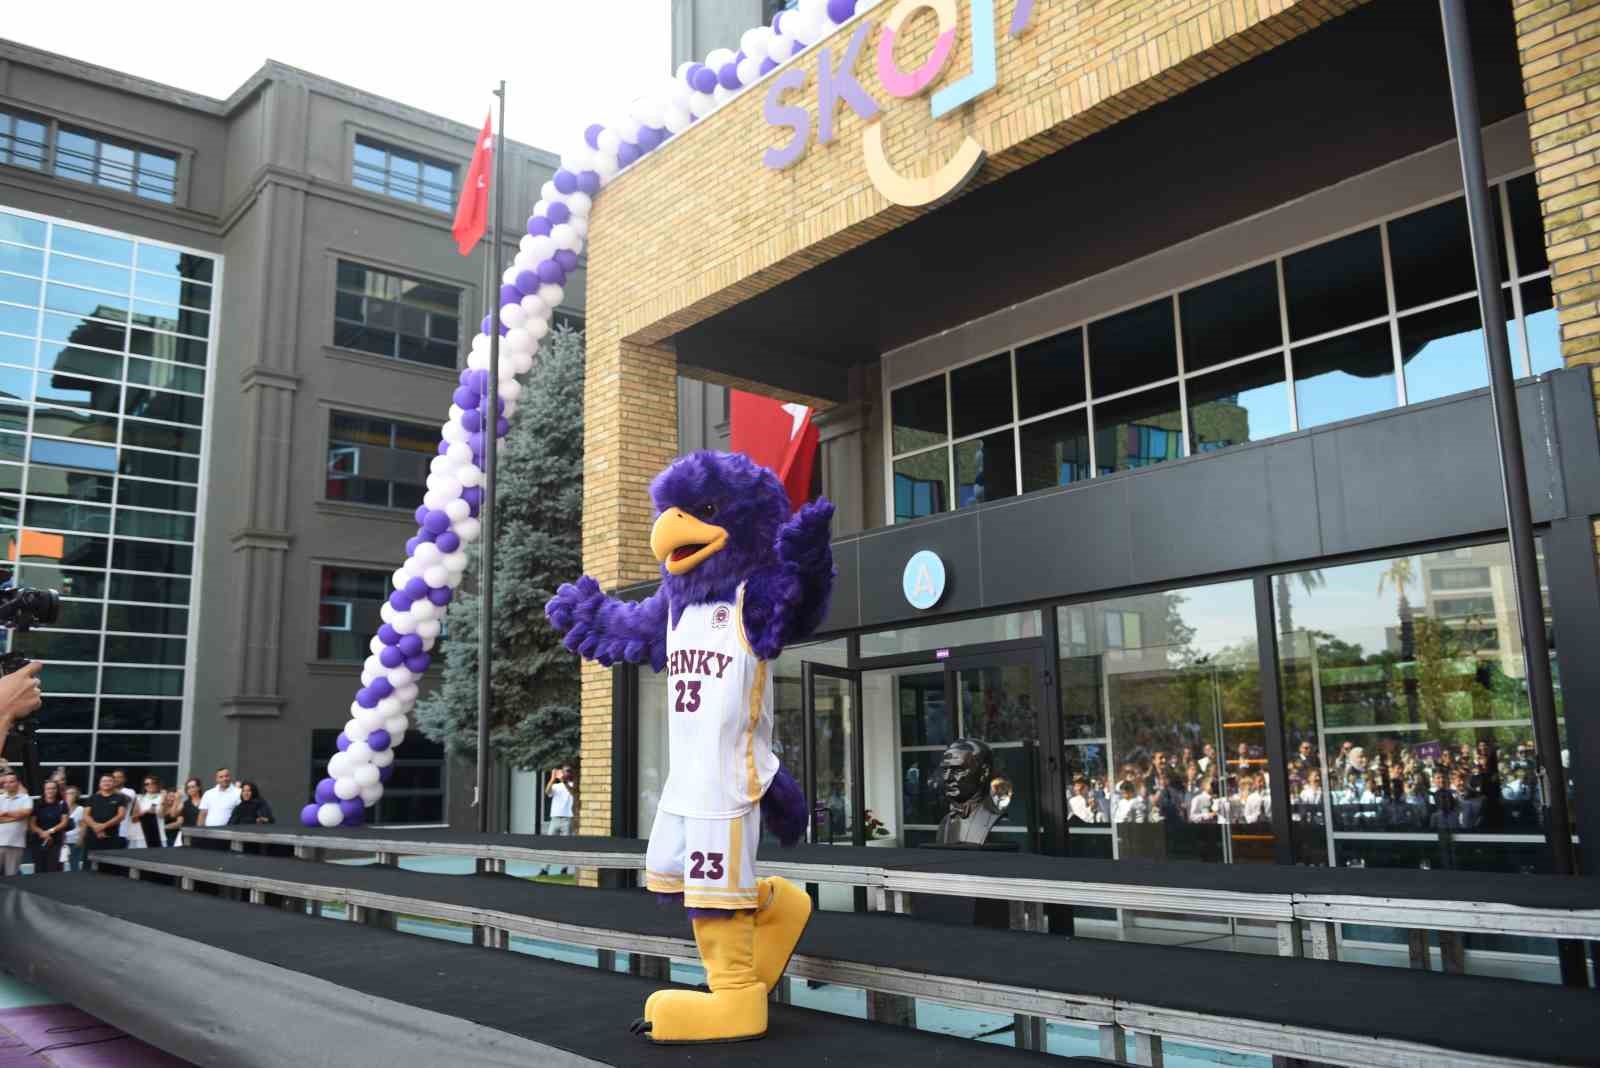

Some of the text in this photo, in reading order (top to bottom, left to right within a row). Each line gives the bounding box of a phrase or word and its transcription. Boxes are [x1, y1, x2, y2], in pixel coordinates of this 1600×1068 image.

[911, 561, 937, 600] A
[666, 649, 733, 679] HNKY
[675, 679, 702, 713] 23
[689, 850, 724, 880] 23
